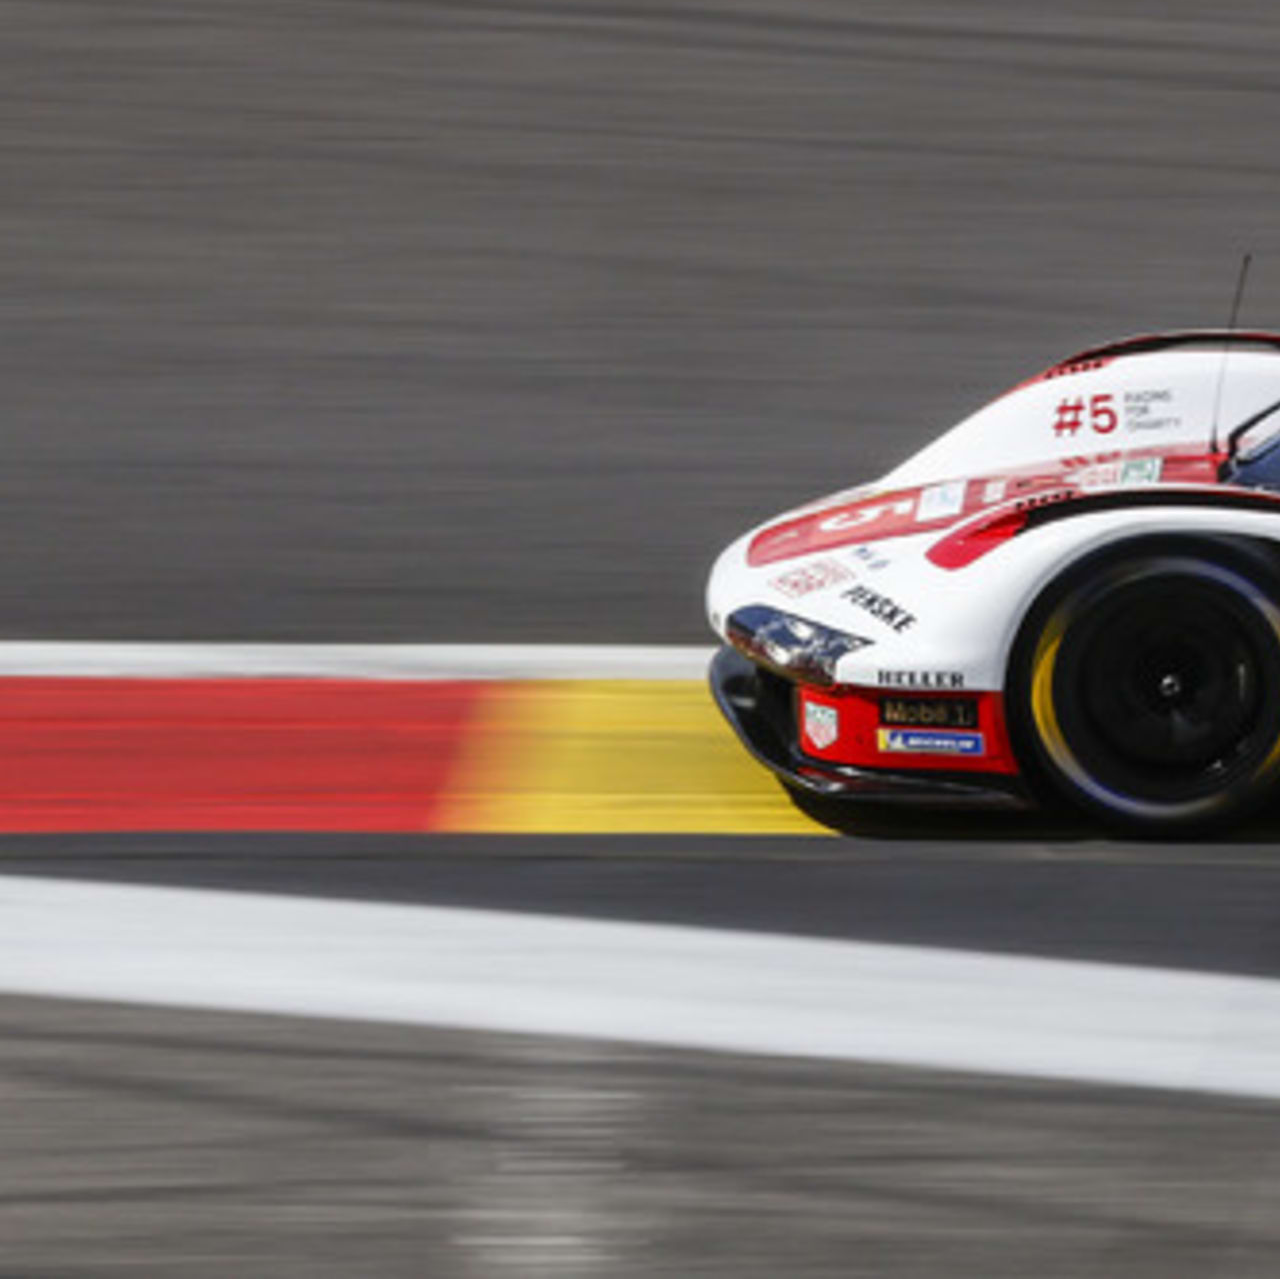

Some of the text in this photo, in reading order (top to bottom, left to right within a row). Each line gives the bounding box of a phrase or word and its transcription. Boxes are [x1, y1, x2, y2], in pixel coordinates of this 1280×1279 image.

[1053, 393, 1118, 436] #5
[841, 585, 918, 634] PENSKE
[877, 670, 965, 688] HELLER
